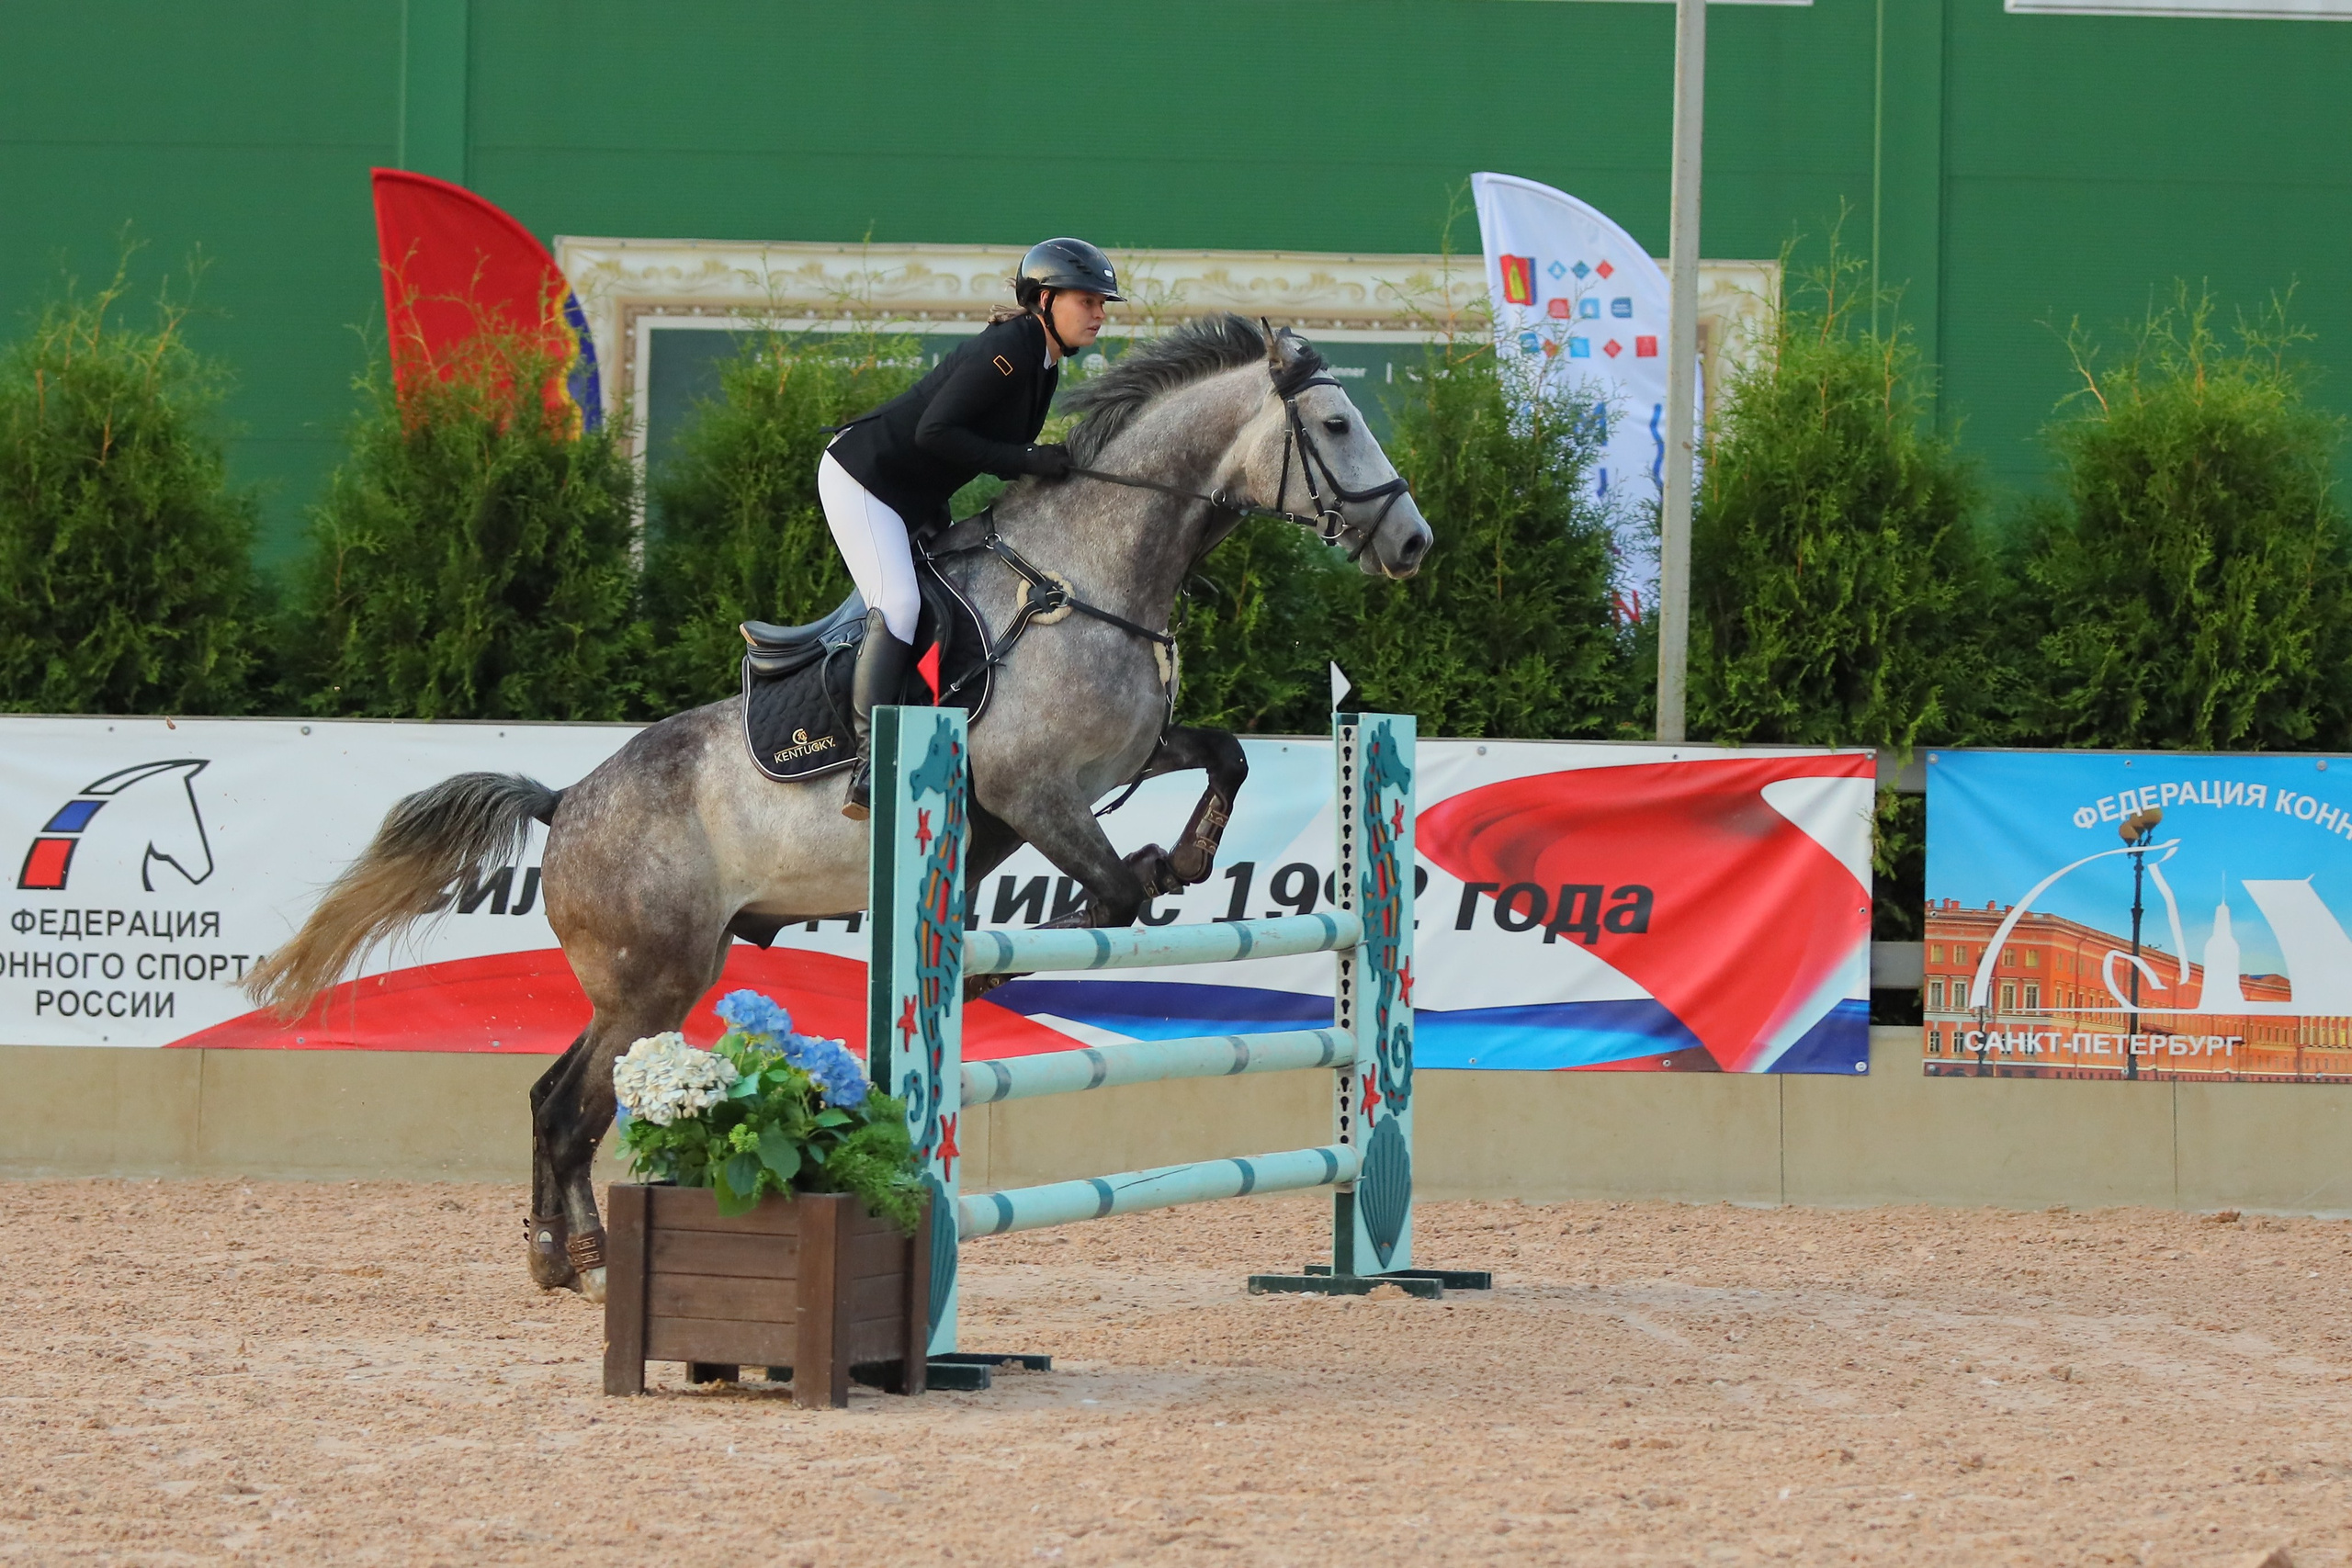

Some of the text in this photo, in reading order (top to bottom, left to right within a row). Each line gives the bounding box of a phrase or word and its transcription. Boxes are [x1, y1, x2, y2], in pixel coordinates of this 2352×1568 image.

[774, 737, 834, 764] KENTUCKY
[2073, 780, 2267, 829] ФЕДЕРАЦИЯ
[1212, 861, 1428, 931] 19
[1454, 881, 1655, 945] года
[10, 908, 220, 942] ФЕДЕРАЦИЯ
[0, 951, 268, 981] ННОГО СПОРТ
[36, 989, 175, 1018] РОССИИ
[1963, 1030, 2243, 1057] САНКТ-ПЕТЕРБУРГ
